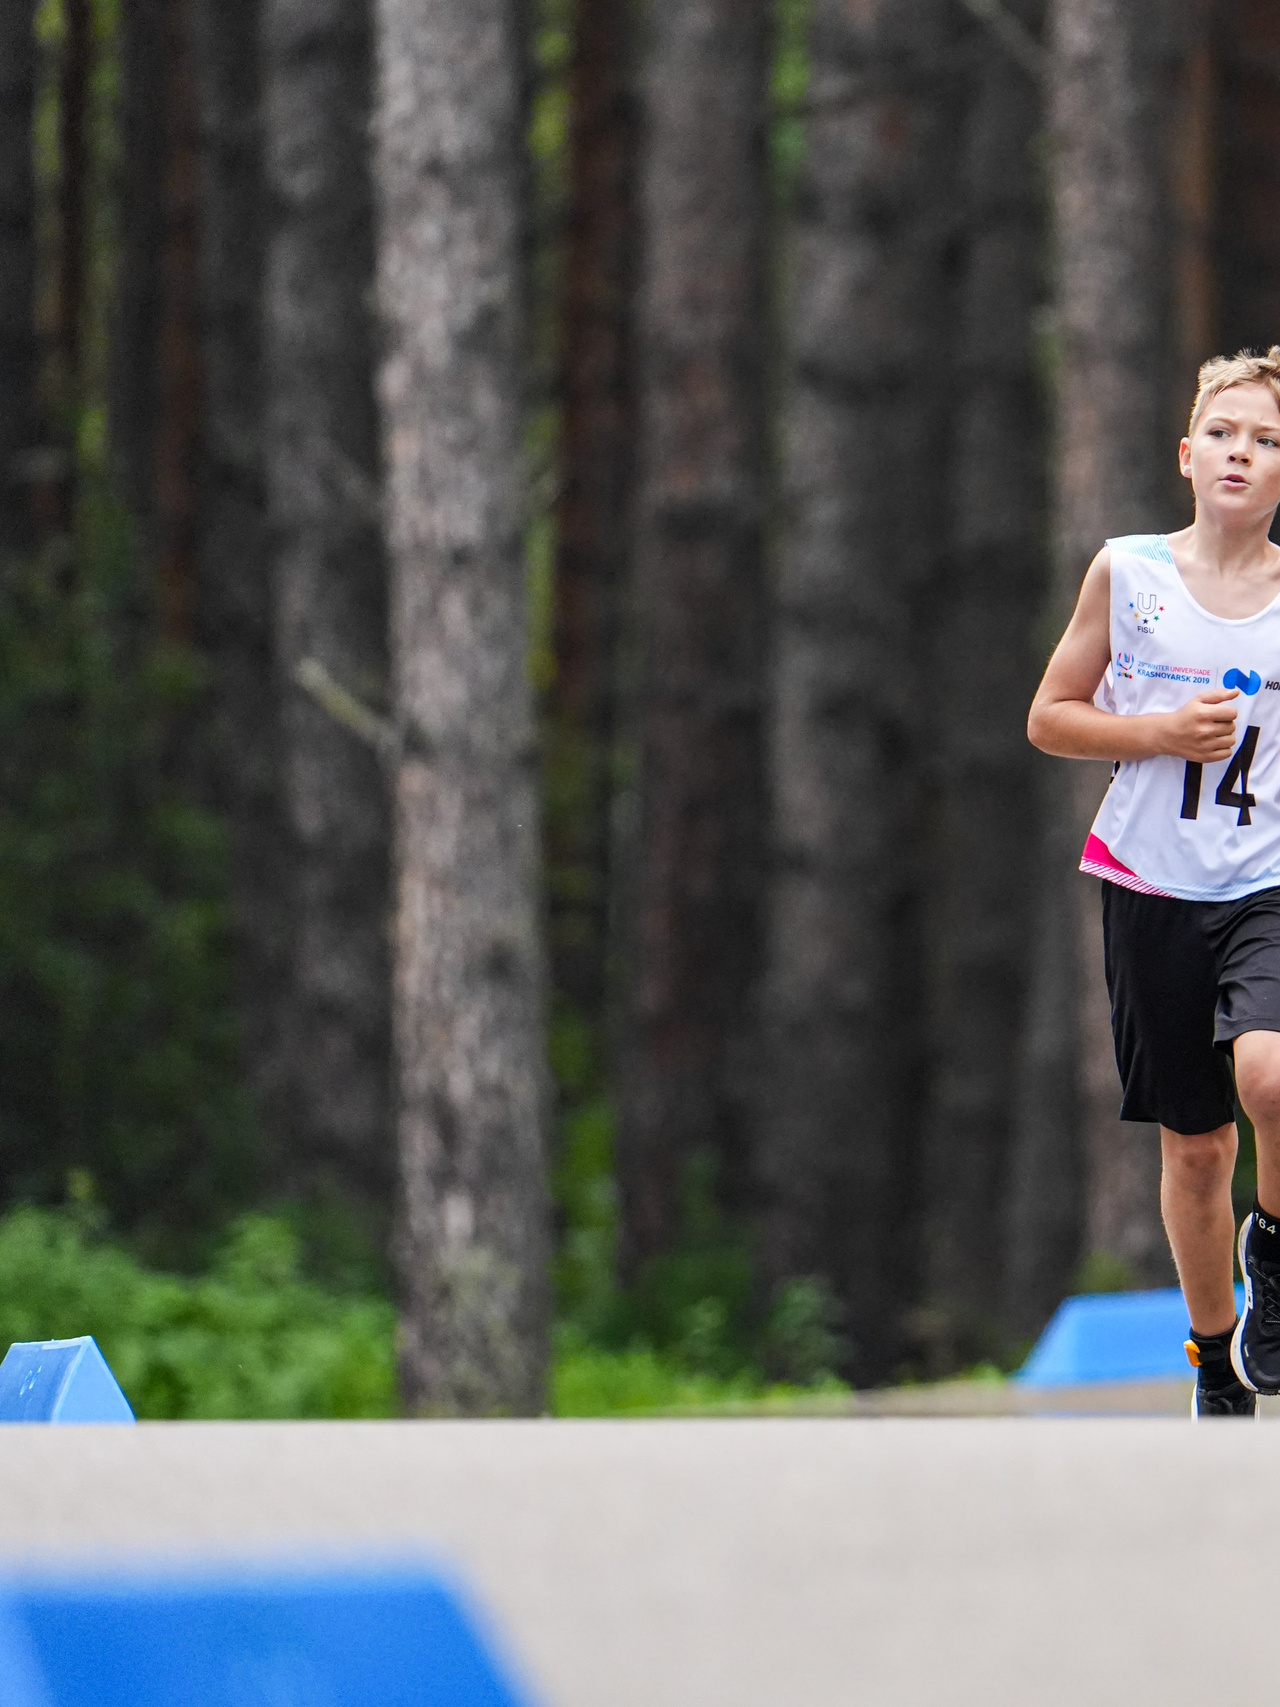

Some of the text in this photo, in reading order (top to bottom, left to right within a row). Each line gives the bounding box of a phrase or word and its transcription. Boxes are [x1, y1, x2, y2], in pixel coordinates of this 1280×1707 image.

[1137, 625, 1155, 635] FISU
[1137, 668, 1210, 685] KRASNOYARSK 2019
[1170, 665, 1212, 677] UNIVERSIADE
[1254, 1212, 1277, 1235] 164
